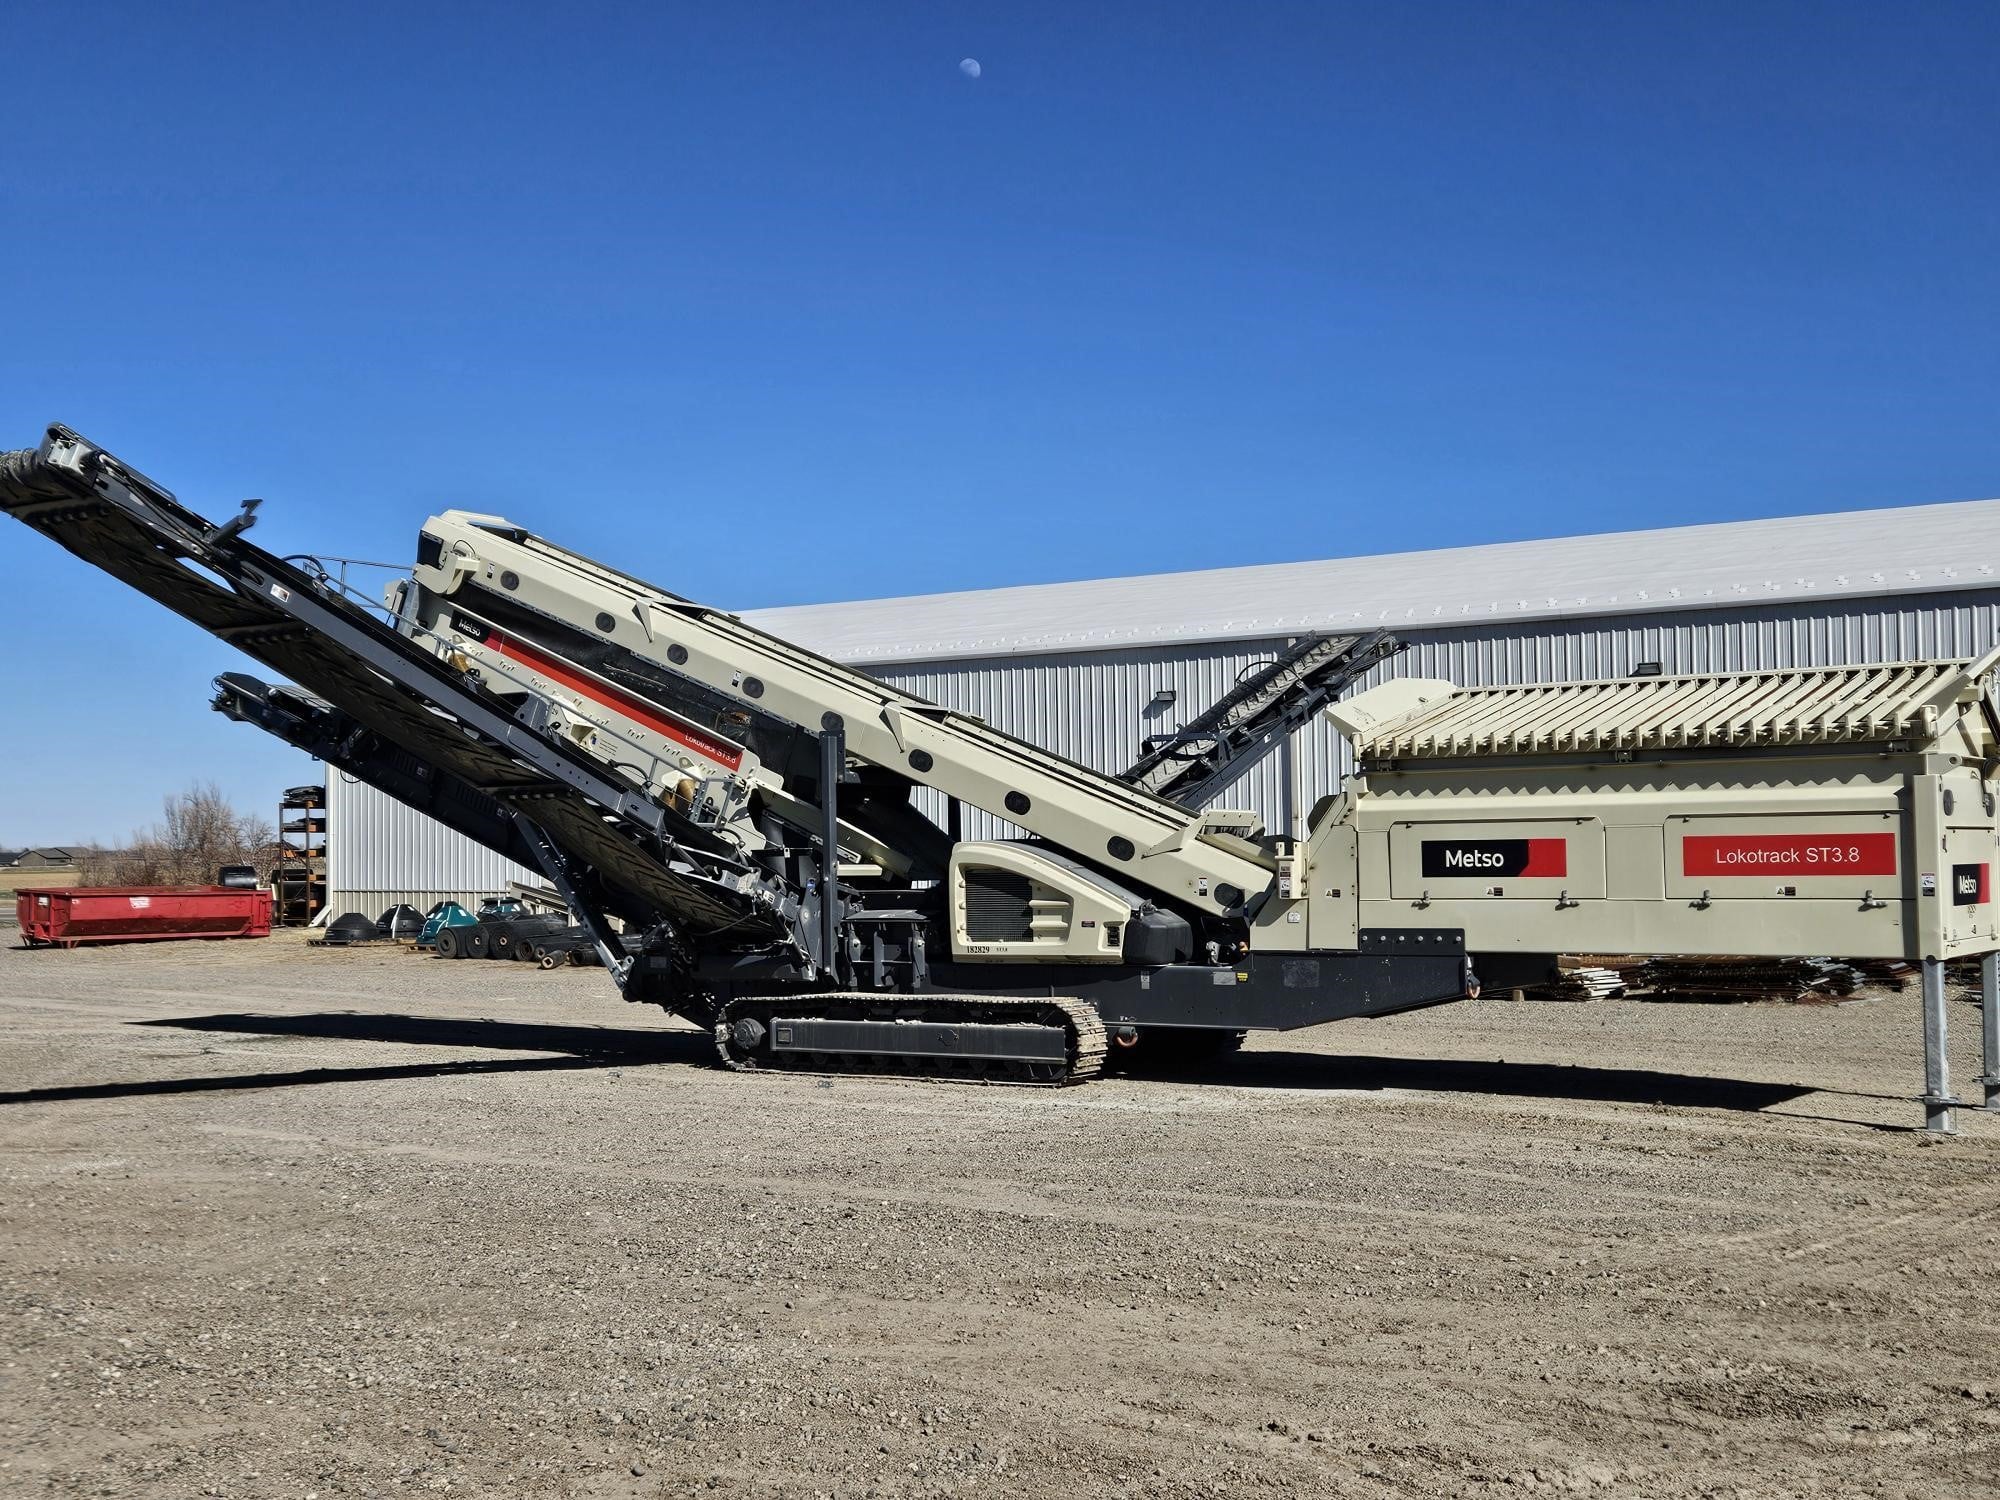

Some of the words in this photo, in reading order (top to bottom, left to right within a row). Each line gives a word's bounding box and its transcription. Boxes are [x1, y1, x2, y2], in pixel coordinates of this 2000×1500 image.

[1445, 849, 1504, 868] Metso
[1716, 847, 1800, 864] Lokotrack
[1806, 847, 1860, 863] ST3.8
[1959, 875, 1976, 894] Metso
